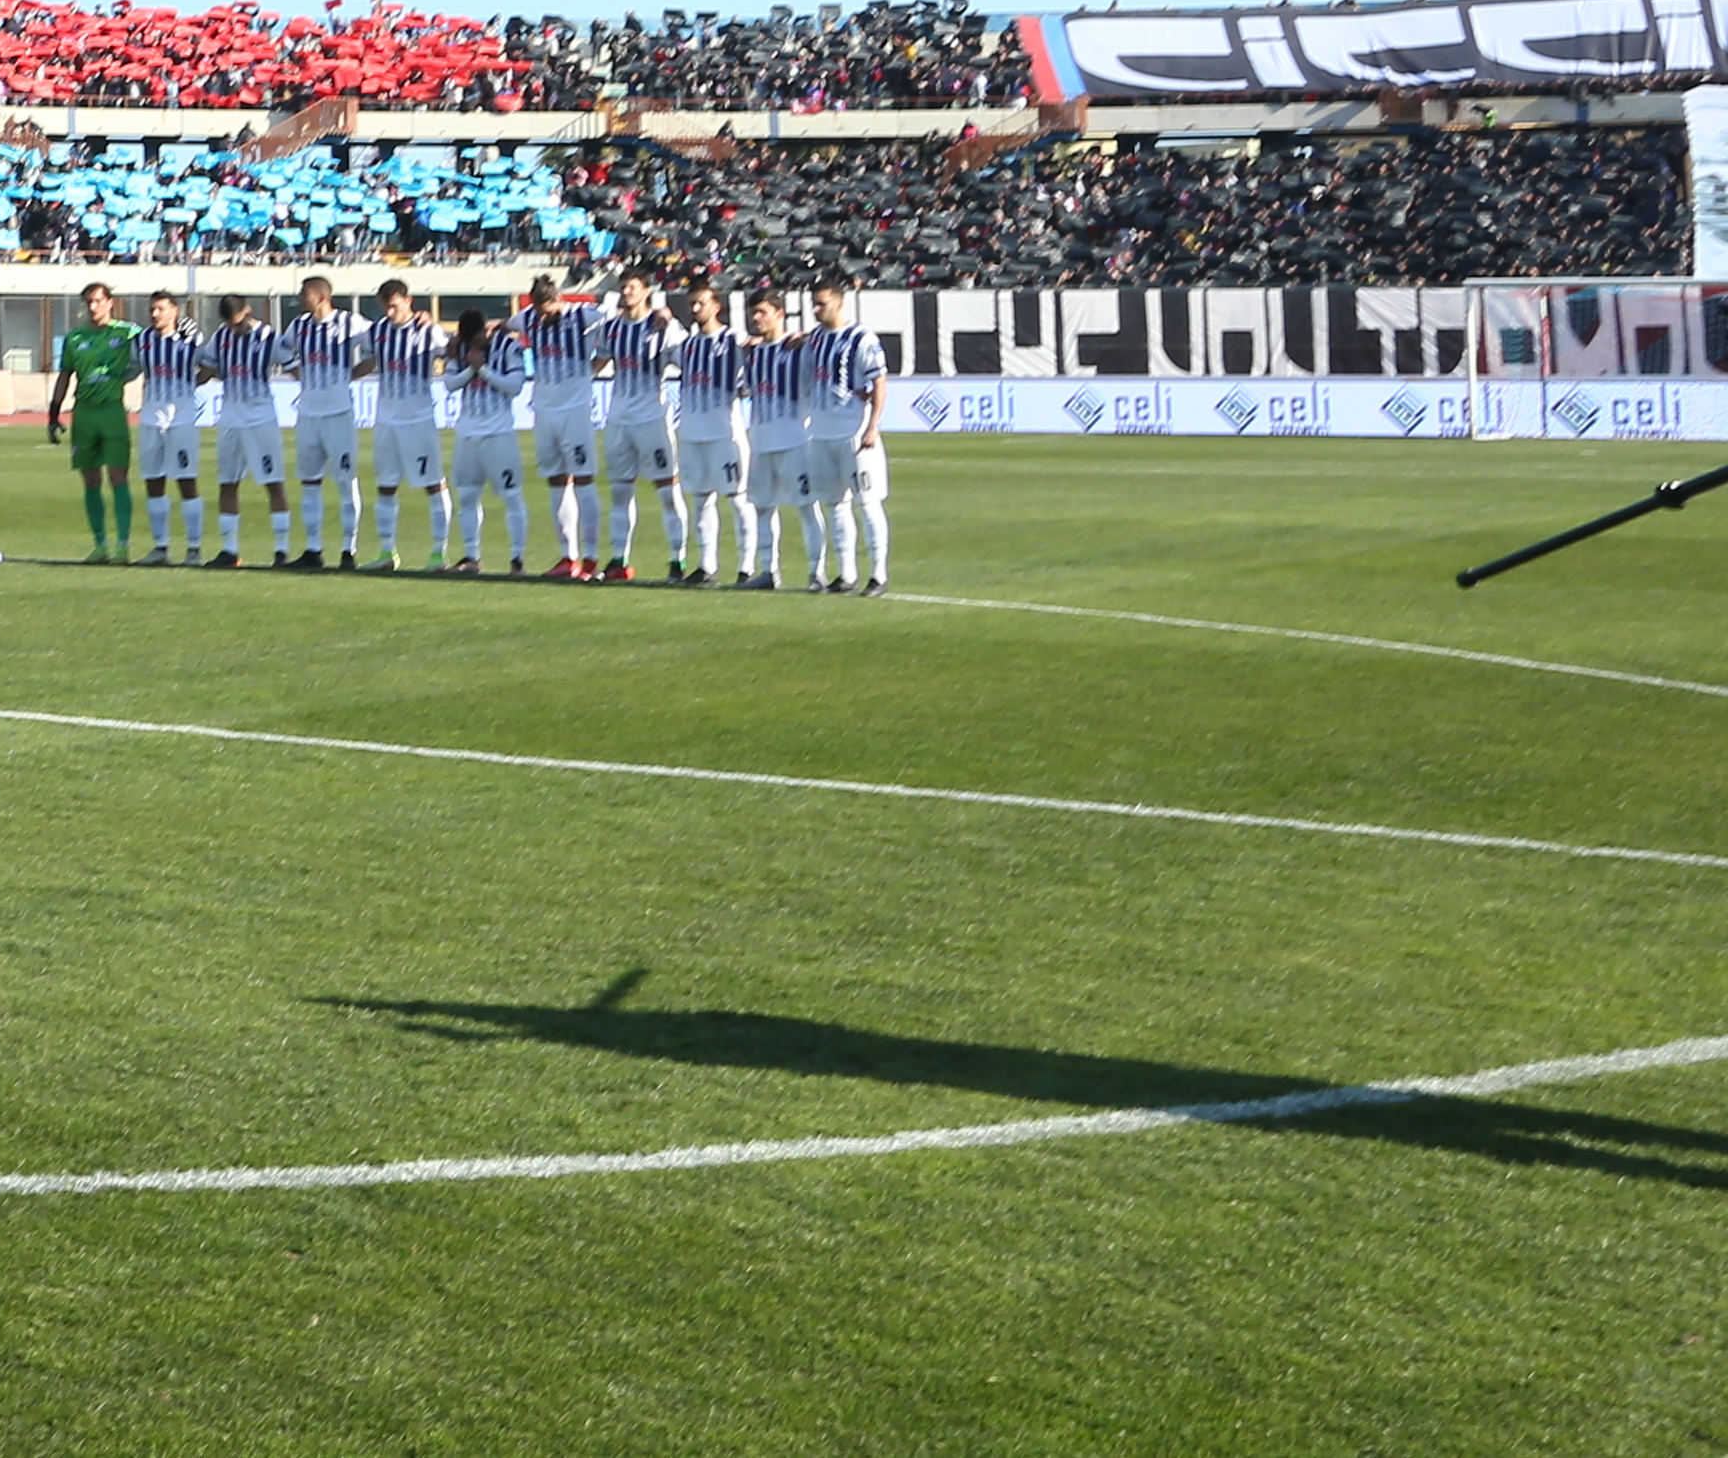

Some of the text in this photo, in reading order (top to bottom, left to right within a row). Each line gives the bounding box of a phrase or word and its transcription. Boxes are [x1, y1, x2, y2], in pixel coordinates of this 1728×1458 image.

[959, 381, 1015, 422] celi
[1113, 381, 1173, 422] celi
[1268, 382, 1331, 423] celi
[1610, 383, 1682, 426] celi
[416, 455, 429, 476] 7
[502, 469, 515, 489] 2
[722, 461, 740, 485] 11
[851, 470, 872, 493] 10
